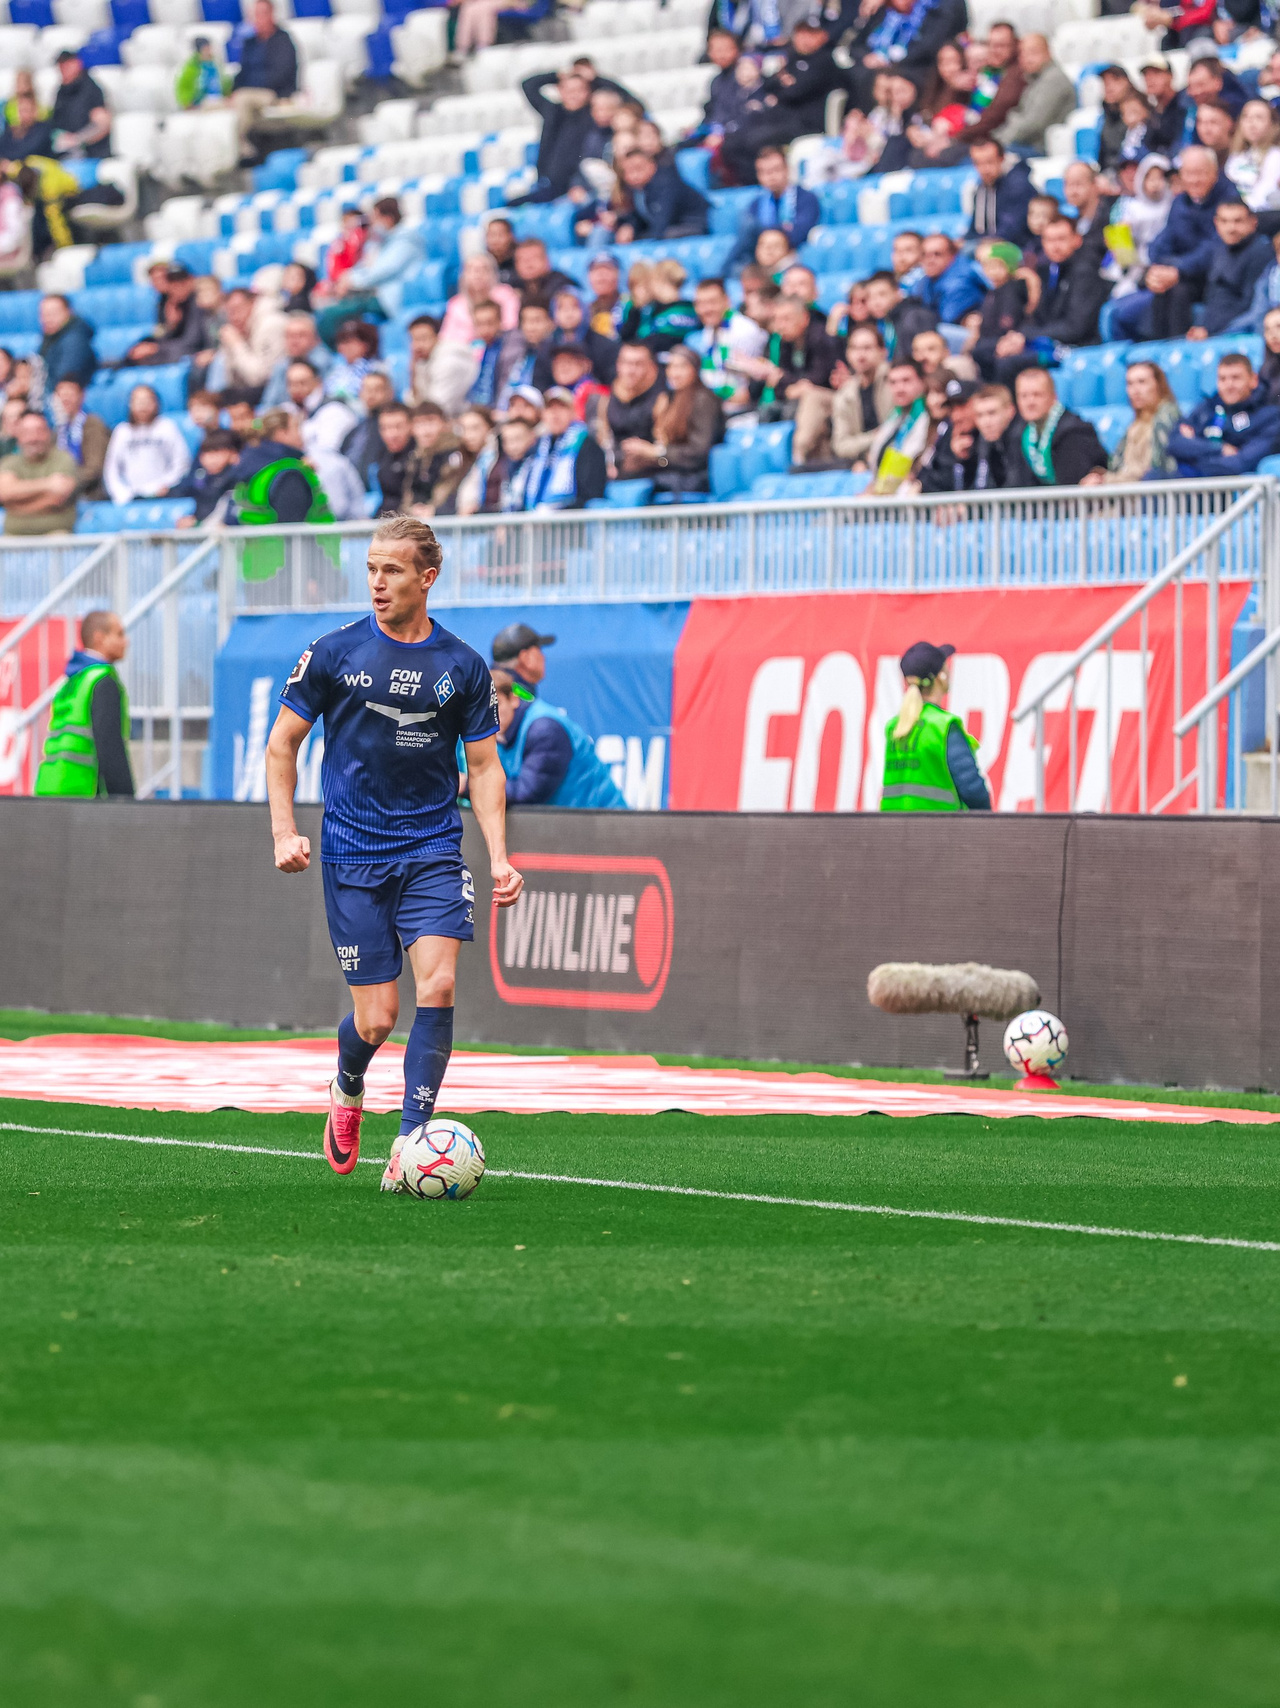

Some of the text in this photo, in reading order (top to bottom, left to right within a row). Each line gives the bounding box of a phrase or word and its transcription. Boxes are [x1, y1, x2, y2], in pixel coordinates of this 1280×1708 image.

[344, 670, 373, 688] wb
[390, 669, 422, 683] FON
[389, 682, 421, 695] BET
[504, 890, 636, 974] WINLINE
[337, 945, 358, 958] FON
[340, 958, 361, 971] BET
[419, 1102, 425, 1110] 2
